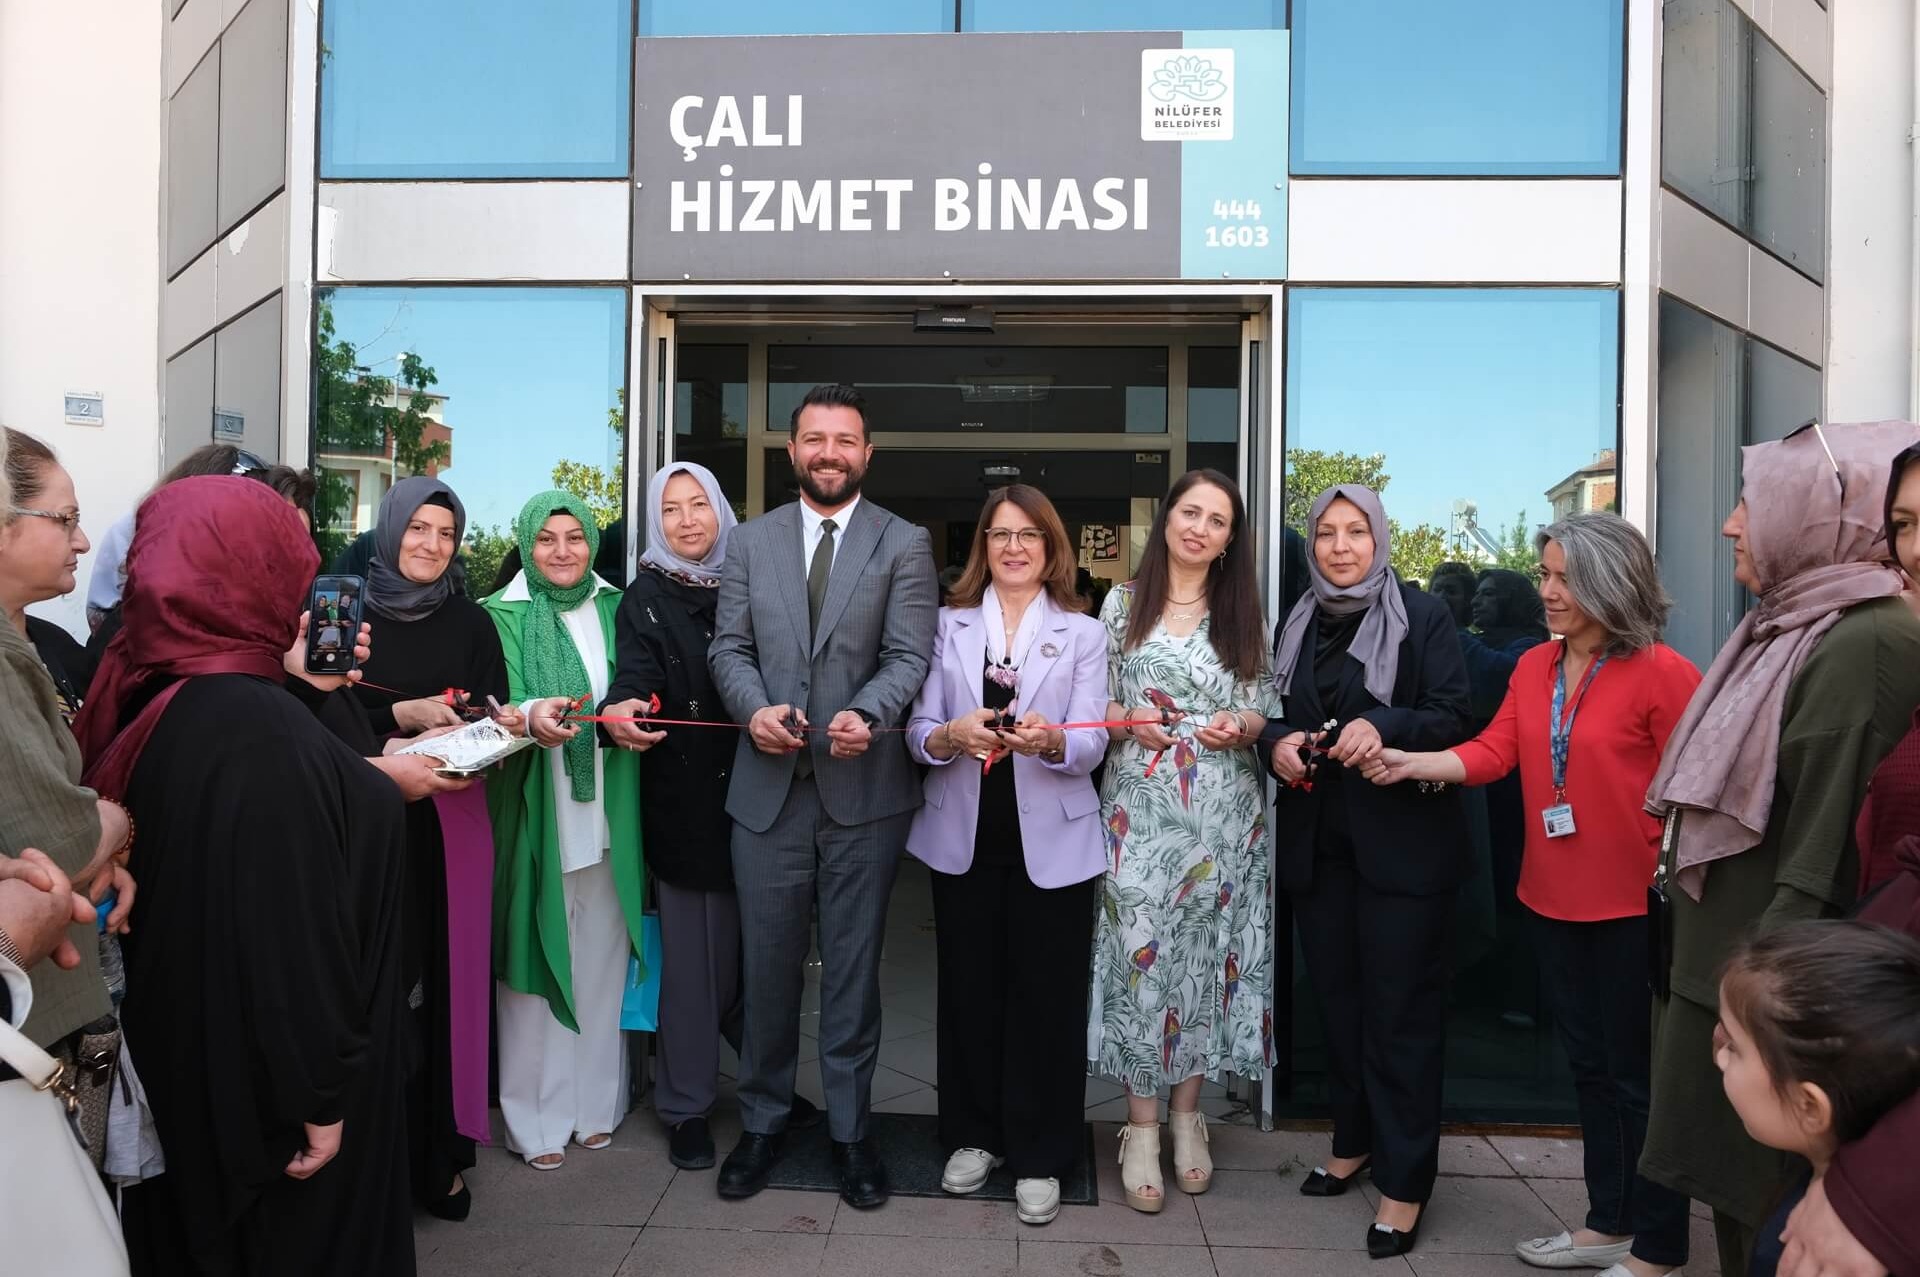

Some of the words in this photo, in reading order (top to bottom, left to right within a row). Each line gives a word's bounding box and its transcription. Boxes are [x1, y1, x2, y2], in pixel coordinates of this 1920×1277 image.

[1154, 104, 1222, 117] NİLÜFER
[669, 94, 803, 162] ÇALI
[1154, 118, 1221, 128] BELEDİYESİ
[670, 163, 914, 232] HİZMET
[934, 162, 1148, 231] BİNASI
[1212, 199, 1262, 221] 444
[1205, 225, 1270, 248] 1603
[79, 402, 89, 415] 2
